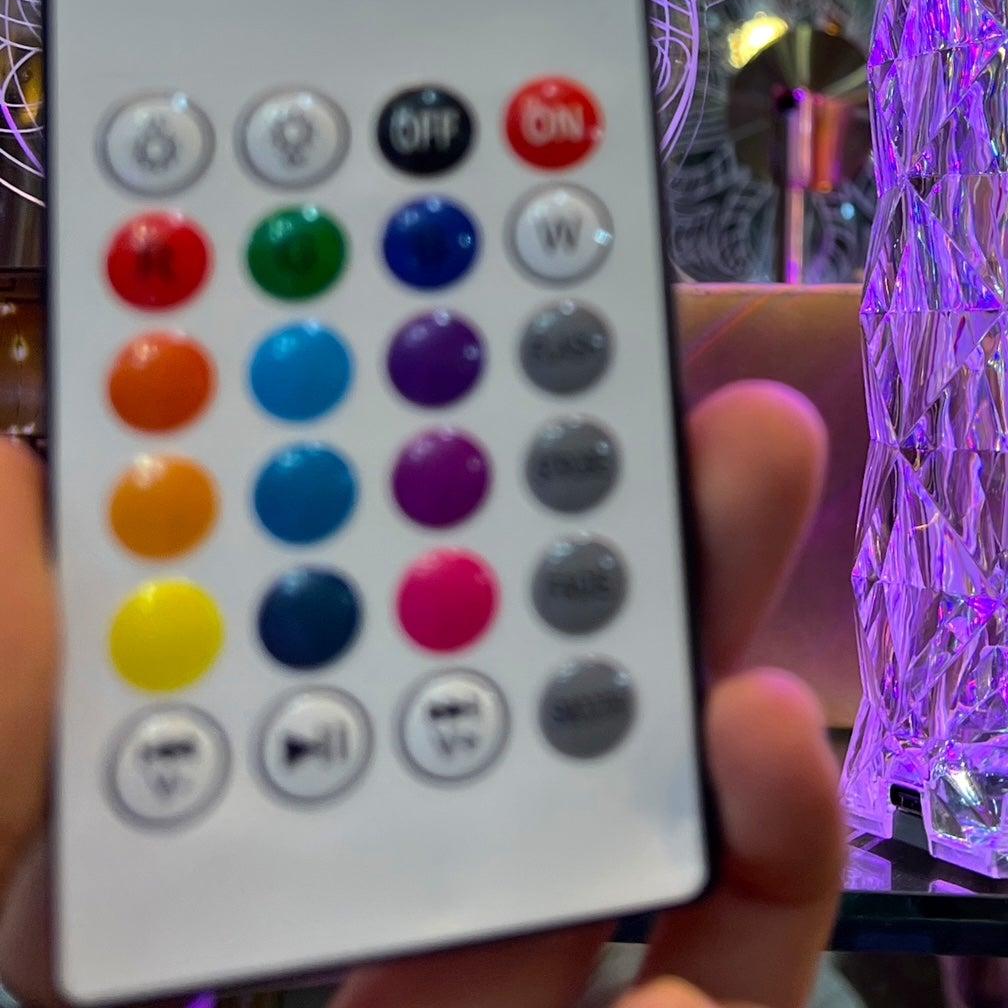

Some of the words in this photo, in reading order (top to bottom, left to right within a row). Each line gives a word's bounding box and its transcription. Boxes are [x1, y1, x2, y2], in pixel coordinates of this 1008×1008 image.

[389, 105, 460, 154] OFF
[521, 95, 585, 148] ON
[533, 215, 584, 257] W
